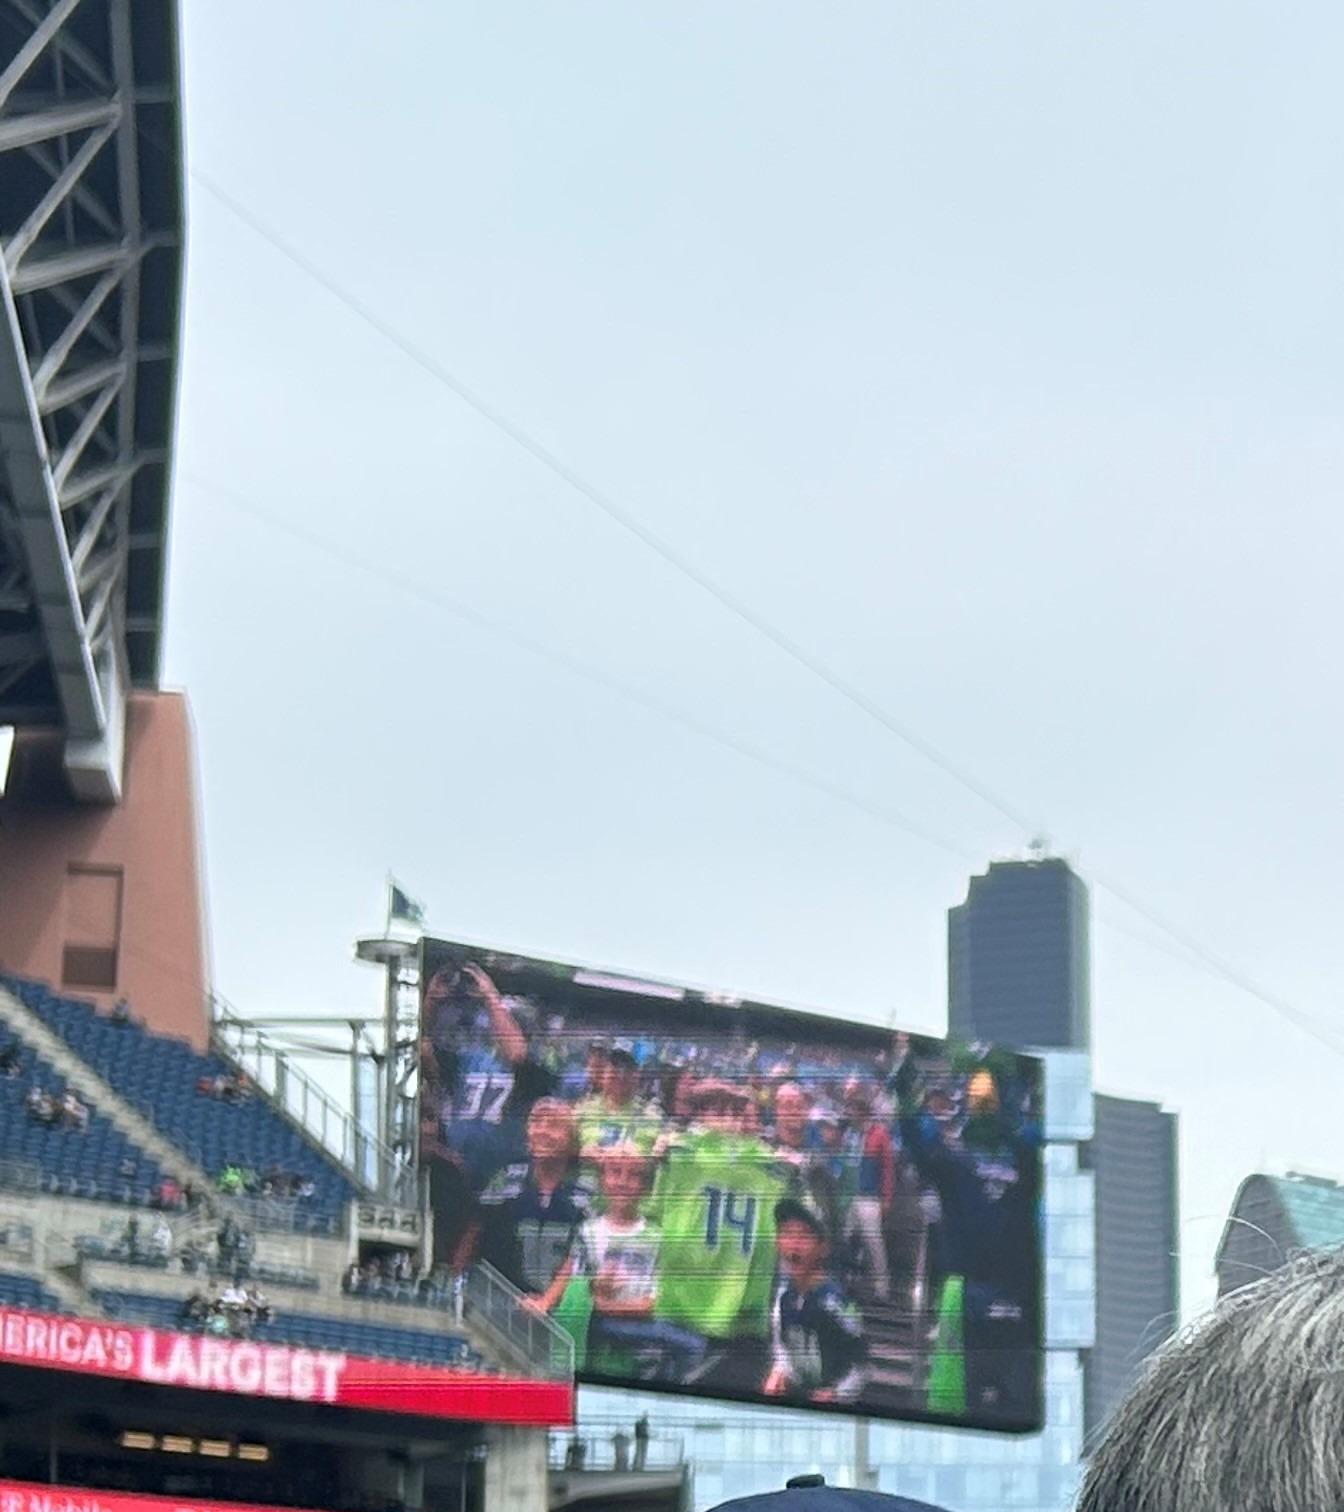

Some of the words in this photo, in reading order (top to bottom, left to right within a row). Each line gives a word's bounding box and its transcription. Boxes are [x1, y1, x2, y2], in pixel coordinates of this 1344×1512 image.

[700, 1180, 755, 1260] 14
[0, 1310, 134, 1371] ERICA'S
[140, 1328, 346, 1402] LARGEST
